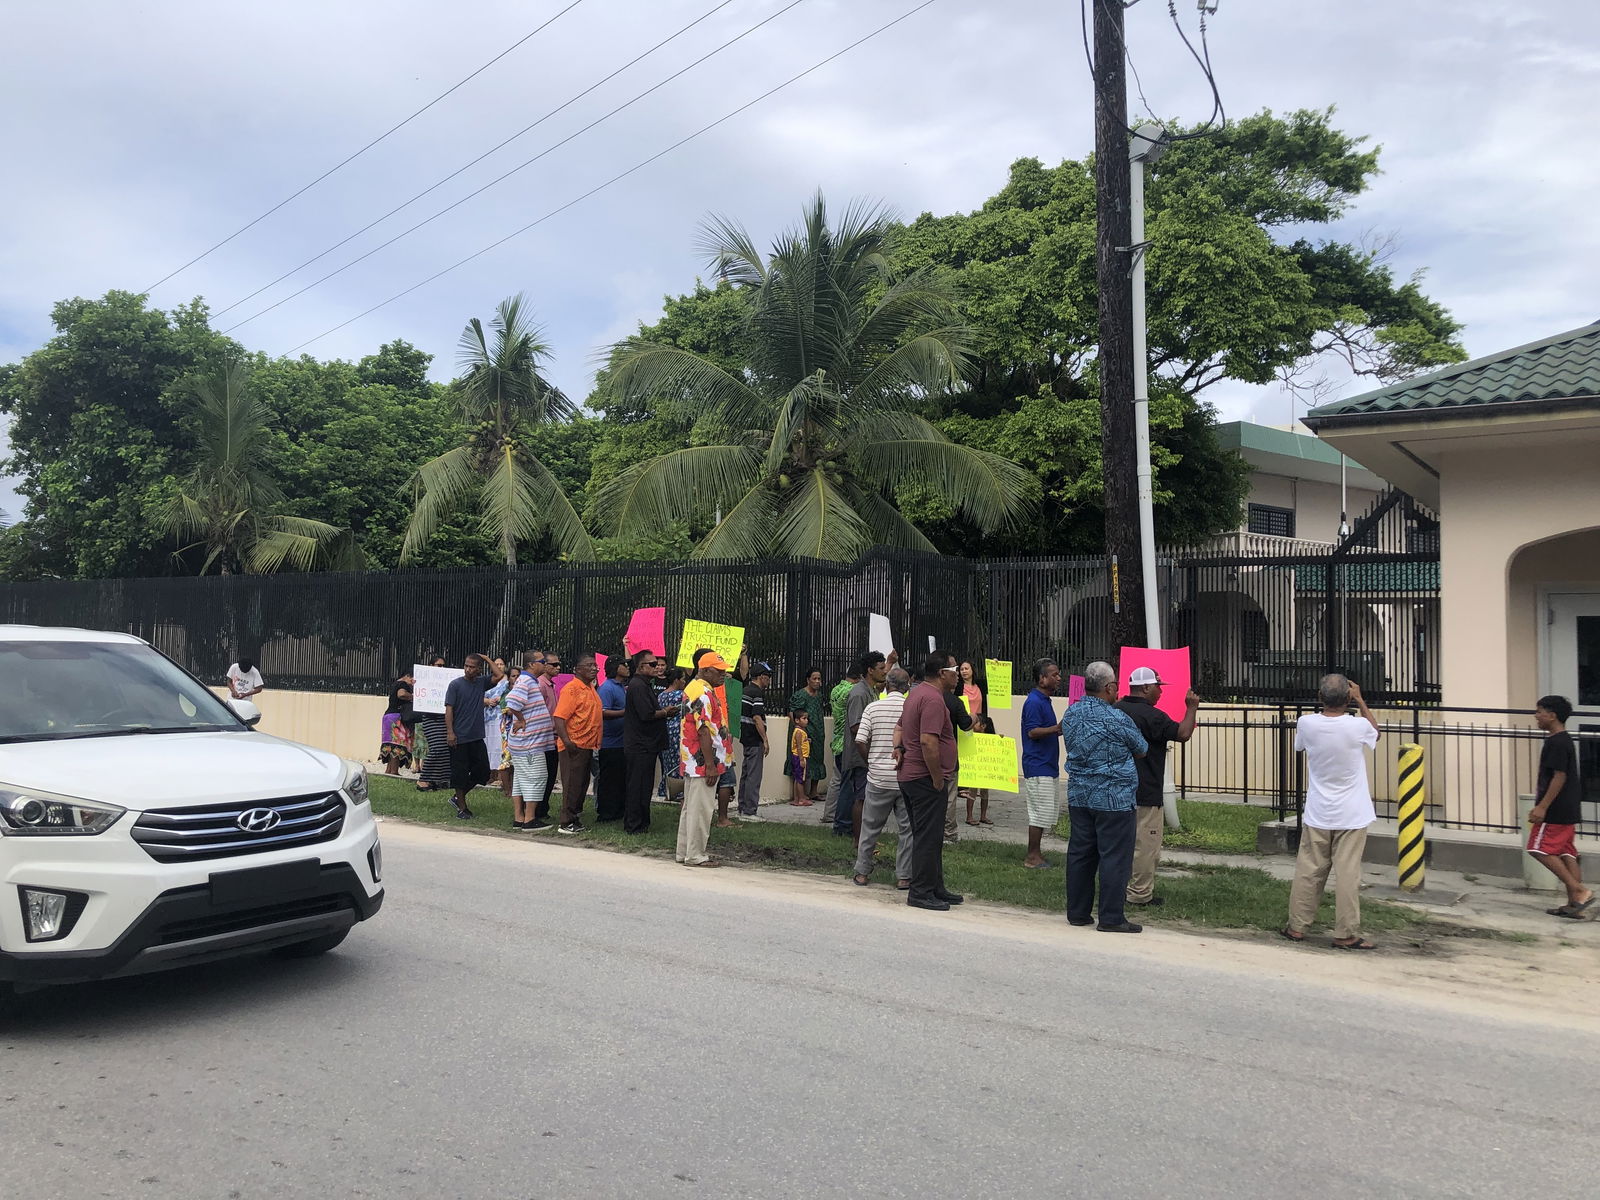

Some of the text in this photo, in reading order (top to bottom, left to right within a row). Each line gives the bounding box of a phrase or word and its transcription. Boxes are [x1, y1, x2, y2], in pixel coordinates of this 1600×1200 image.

[686, 619, 731, 637] THE CLAIMS
[684, 631, 738, 646] TRUST FUND
[683, 642, 692, 651] IS
[716, 646, 732, 657] FOR
[415, 687, 427, 698] US
